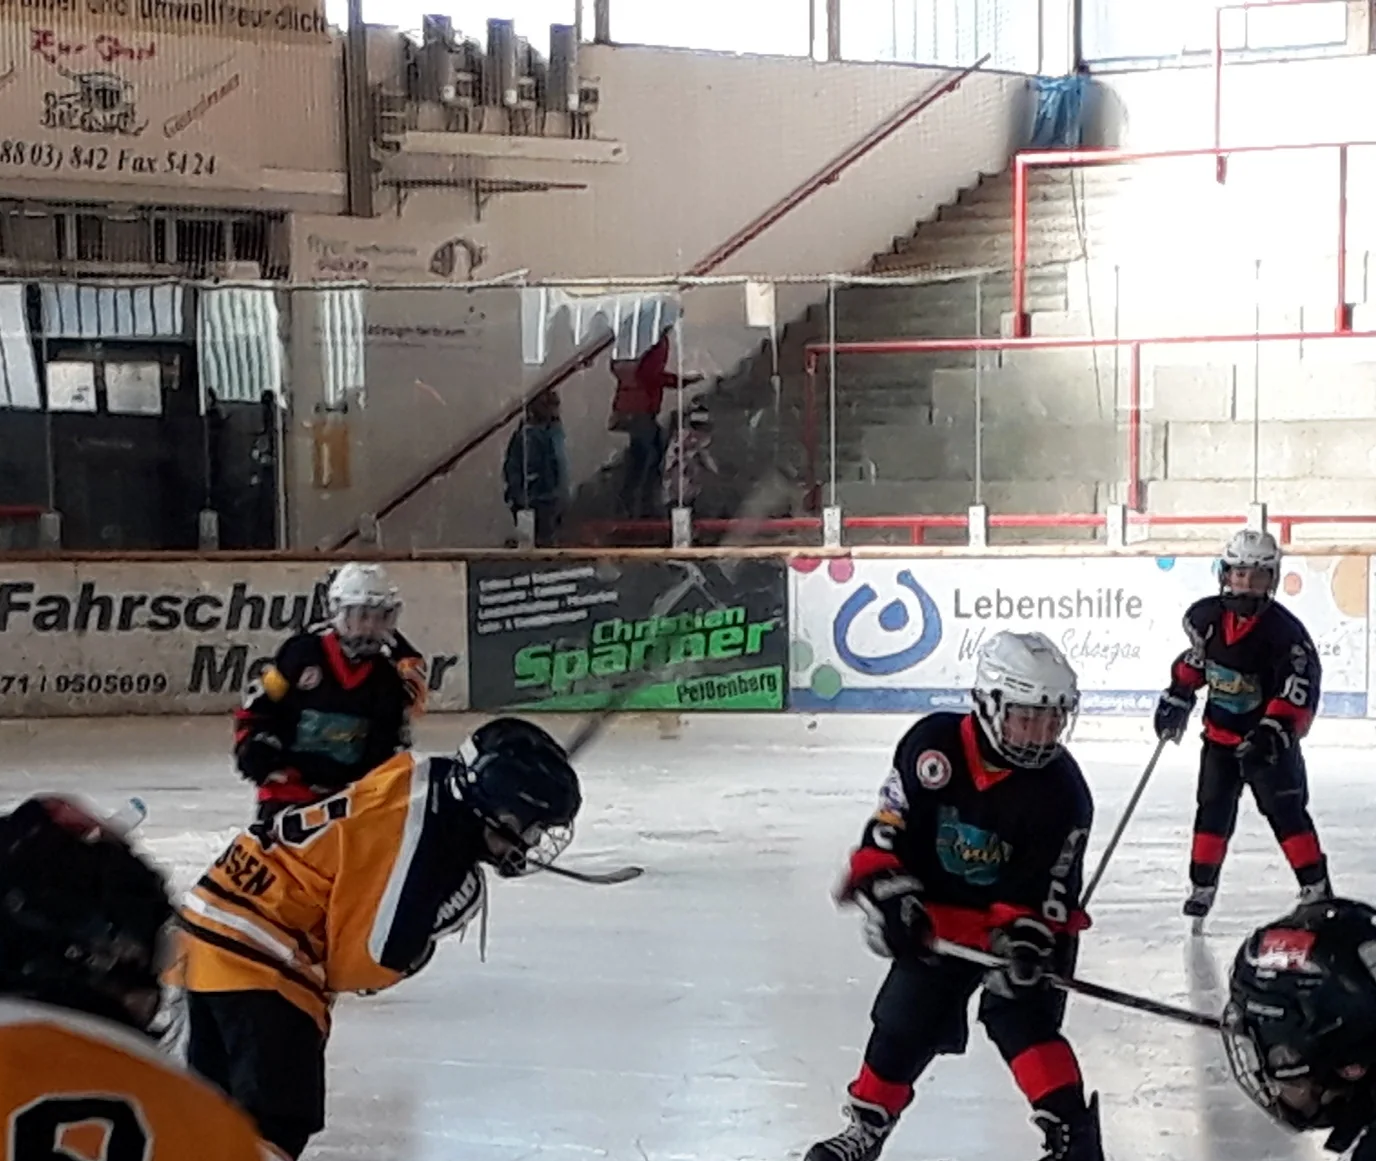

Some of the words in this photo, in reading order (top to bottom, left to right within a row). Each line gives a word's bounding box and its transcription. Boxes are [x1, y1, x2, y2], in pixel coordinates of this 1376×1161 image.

[68, 146, 108, 171] 842
[116, 148, 159, 173] Fax
[954, 588, 1143, 620] Lebenshilfe
[591, 606, 746, 646] Christian
